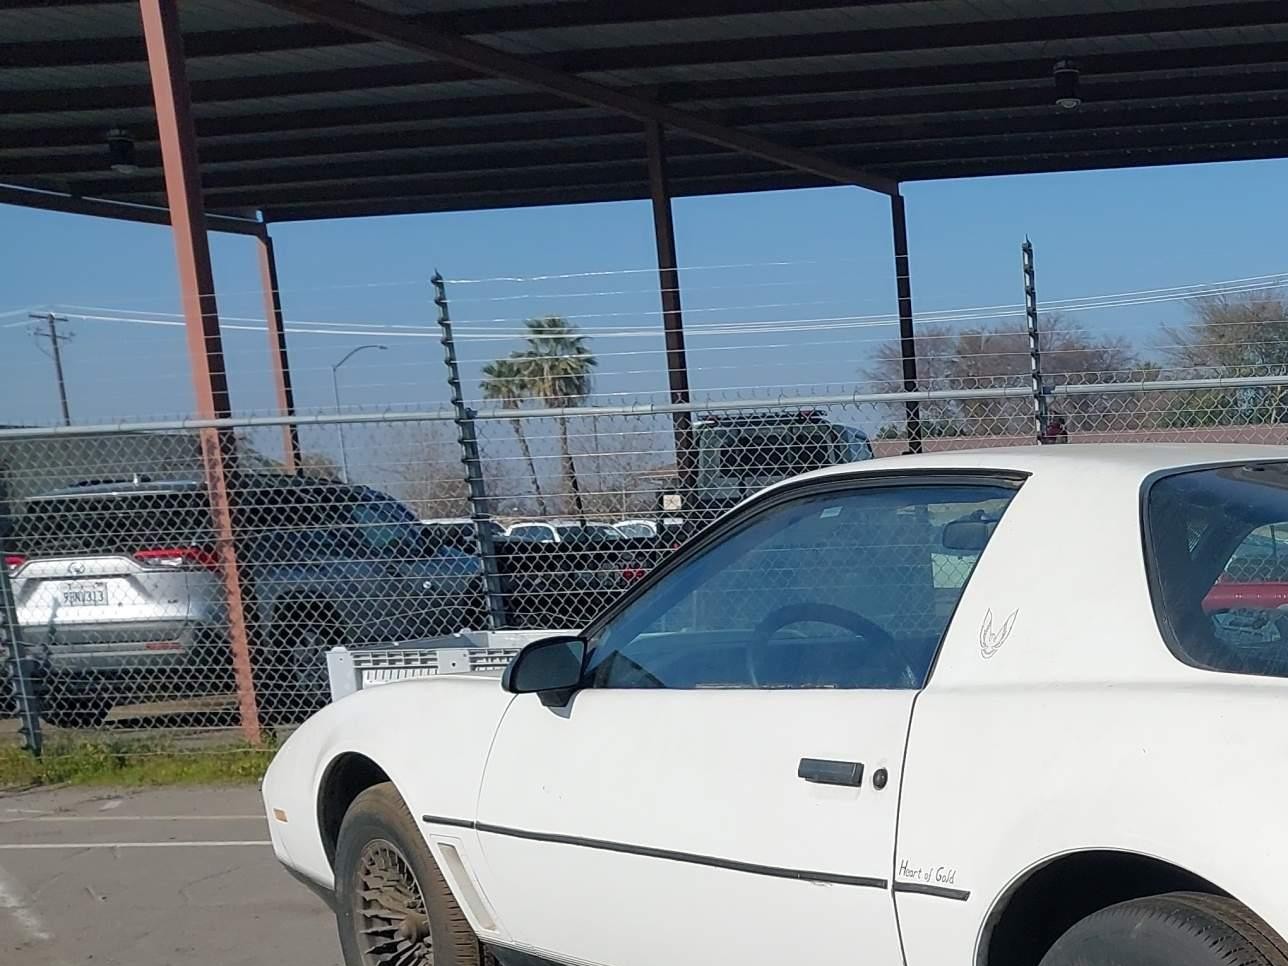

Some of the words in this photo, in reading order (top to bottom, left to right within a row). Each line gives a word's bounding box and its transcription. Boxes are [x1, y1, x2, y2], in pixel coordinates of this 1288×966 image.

[898, 859, 922, 879] Heart
[924, 867, 934, 882] of
[935, 866, 957, 884] Gold
